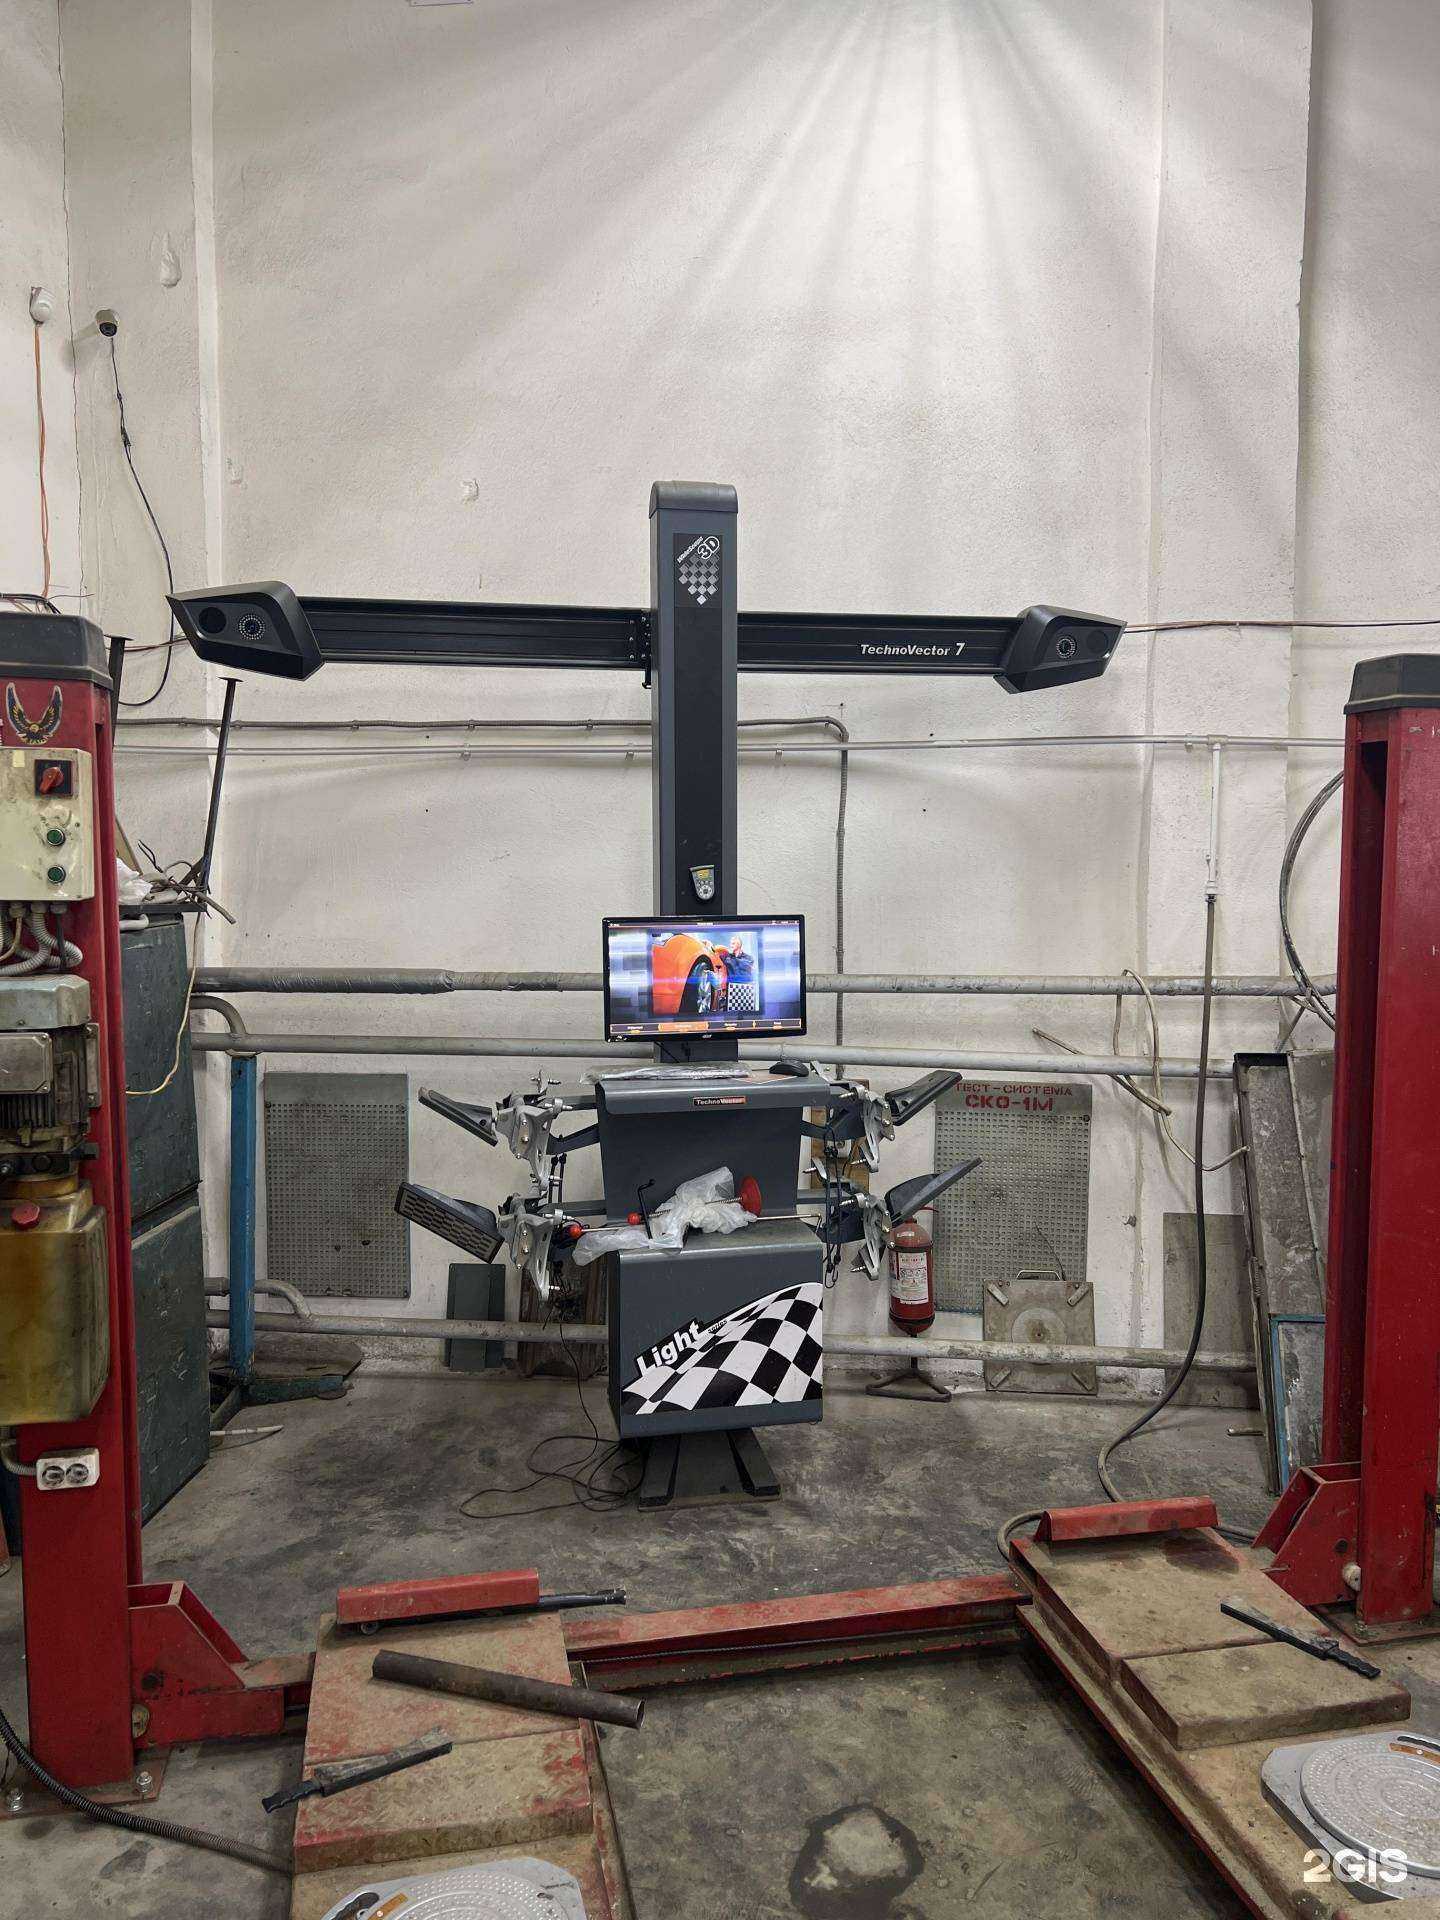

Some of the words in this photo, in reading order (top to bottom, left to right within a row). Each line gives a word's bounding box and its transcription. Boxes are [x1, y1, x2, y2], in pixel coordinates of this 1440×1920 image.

[697, 535, 719, 559] 3D
[860, 643, 951, 656] TechnoVector
[955, 642, 966, 656] 7
[965, 1094, 1055, 1111] СКО-1М
[636, 1321, 699, 1375] Light
